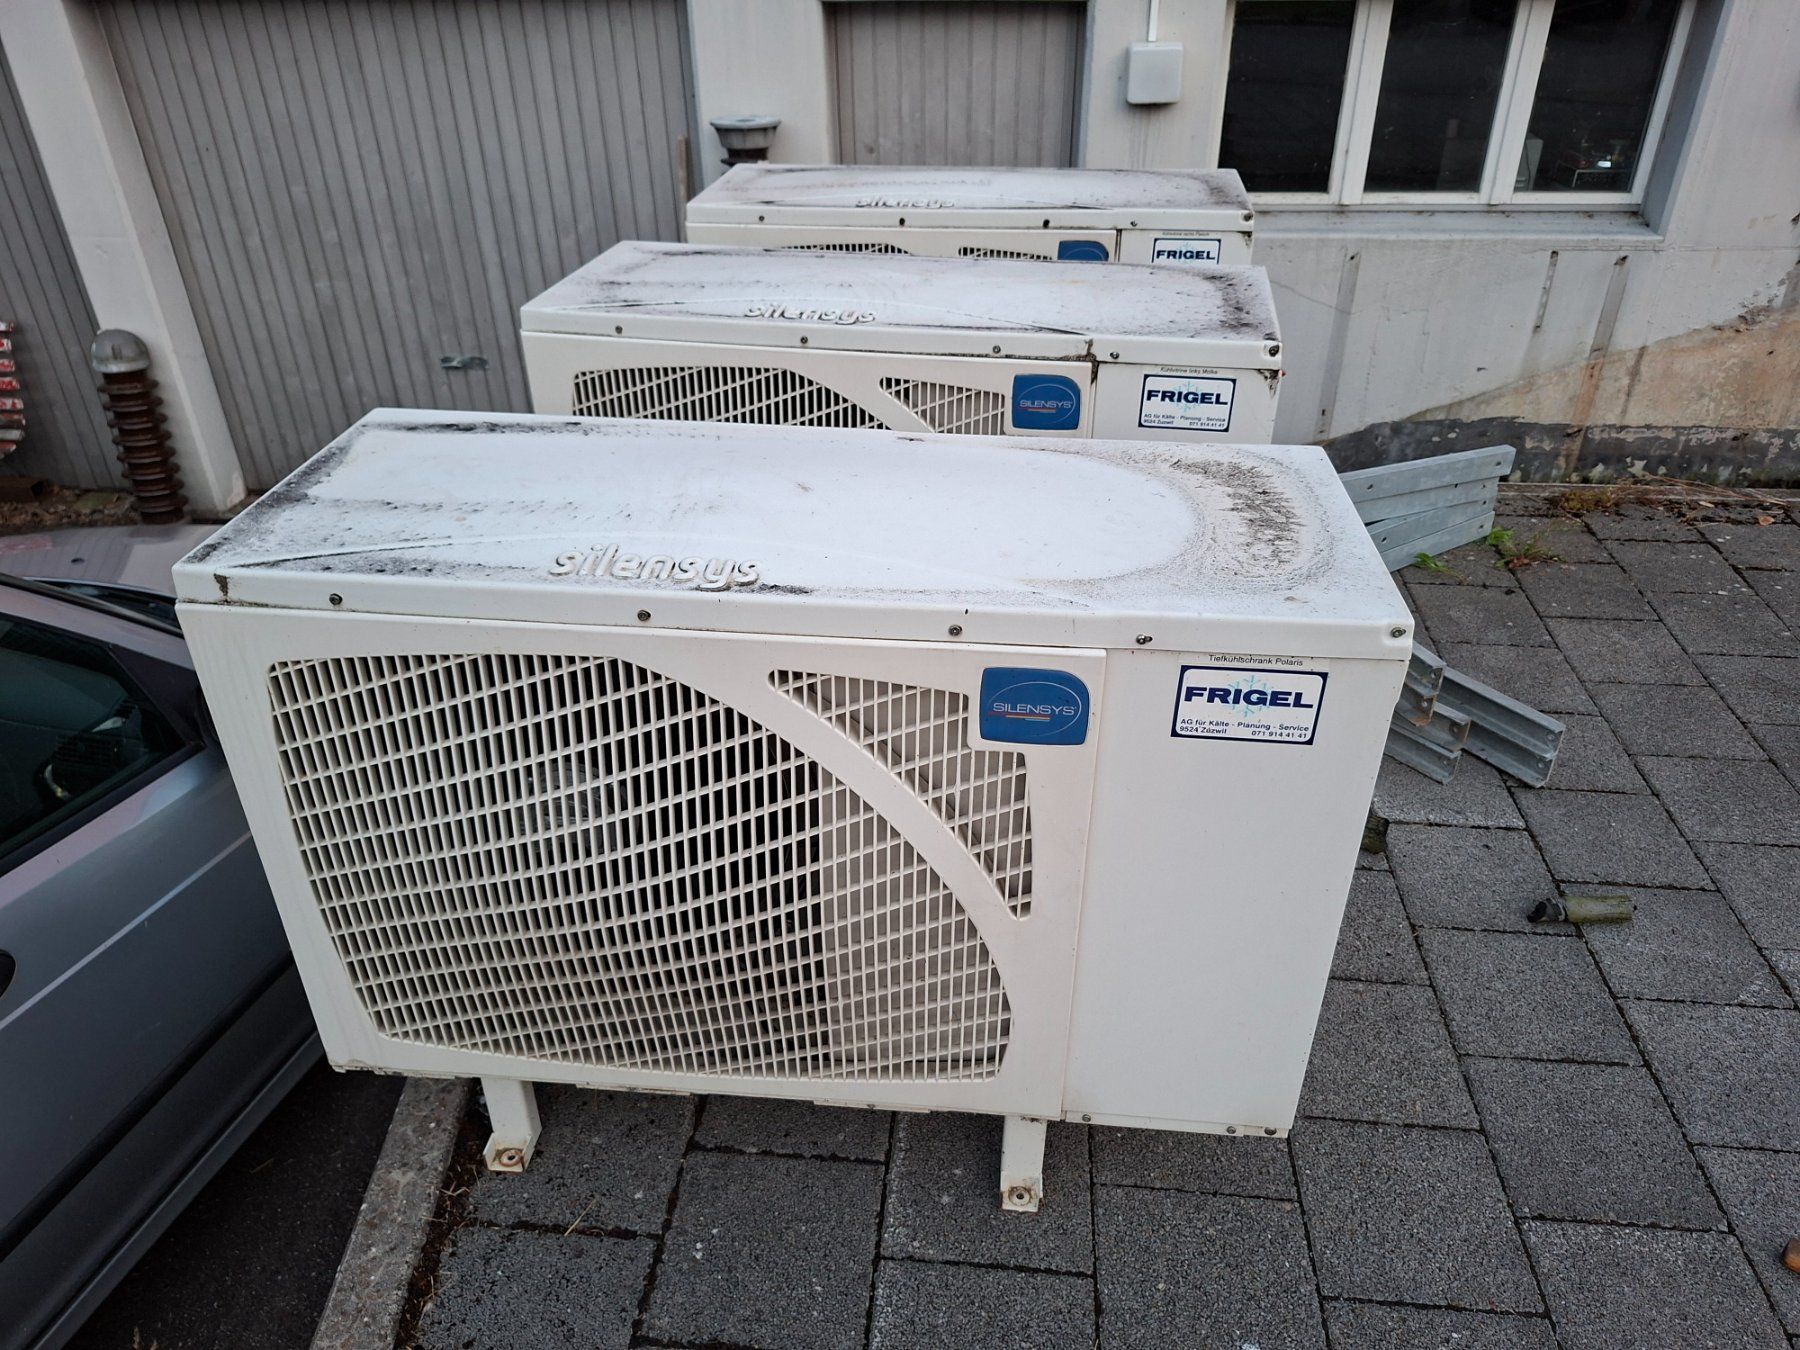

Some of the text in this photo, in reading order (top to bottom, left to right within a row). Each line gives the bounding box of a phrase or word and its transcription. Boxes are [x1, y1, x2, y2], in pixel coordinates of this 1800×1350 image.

[1156, 250, 1216, 260] FRIGEL
[744, 303, 876, 325] silensys
[1020, 400, 1072, 409] SILENSYS
[1145, 390, 1228, 405] FRIGEL
[550, 543, 761, 592] silensys
[1209, 654, 1304, 667] Tiefkühlschrank Polaris
[1184, 686, 1314, 709] FRIGEL
[993, 702, 1075, 716] SILENSYS
[1237, 721, 1271, 731] Planung
[1278, 724, 1310, 732] Service
